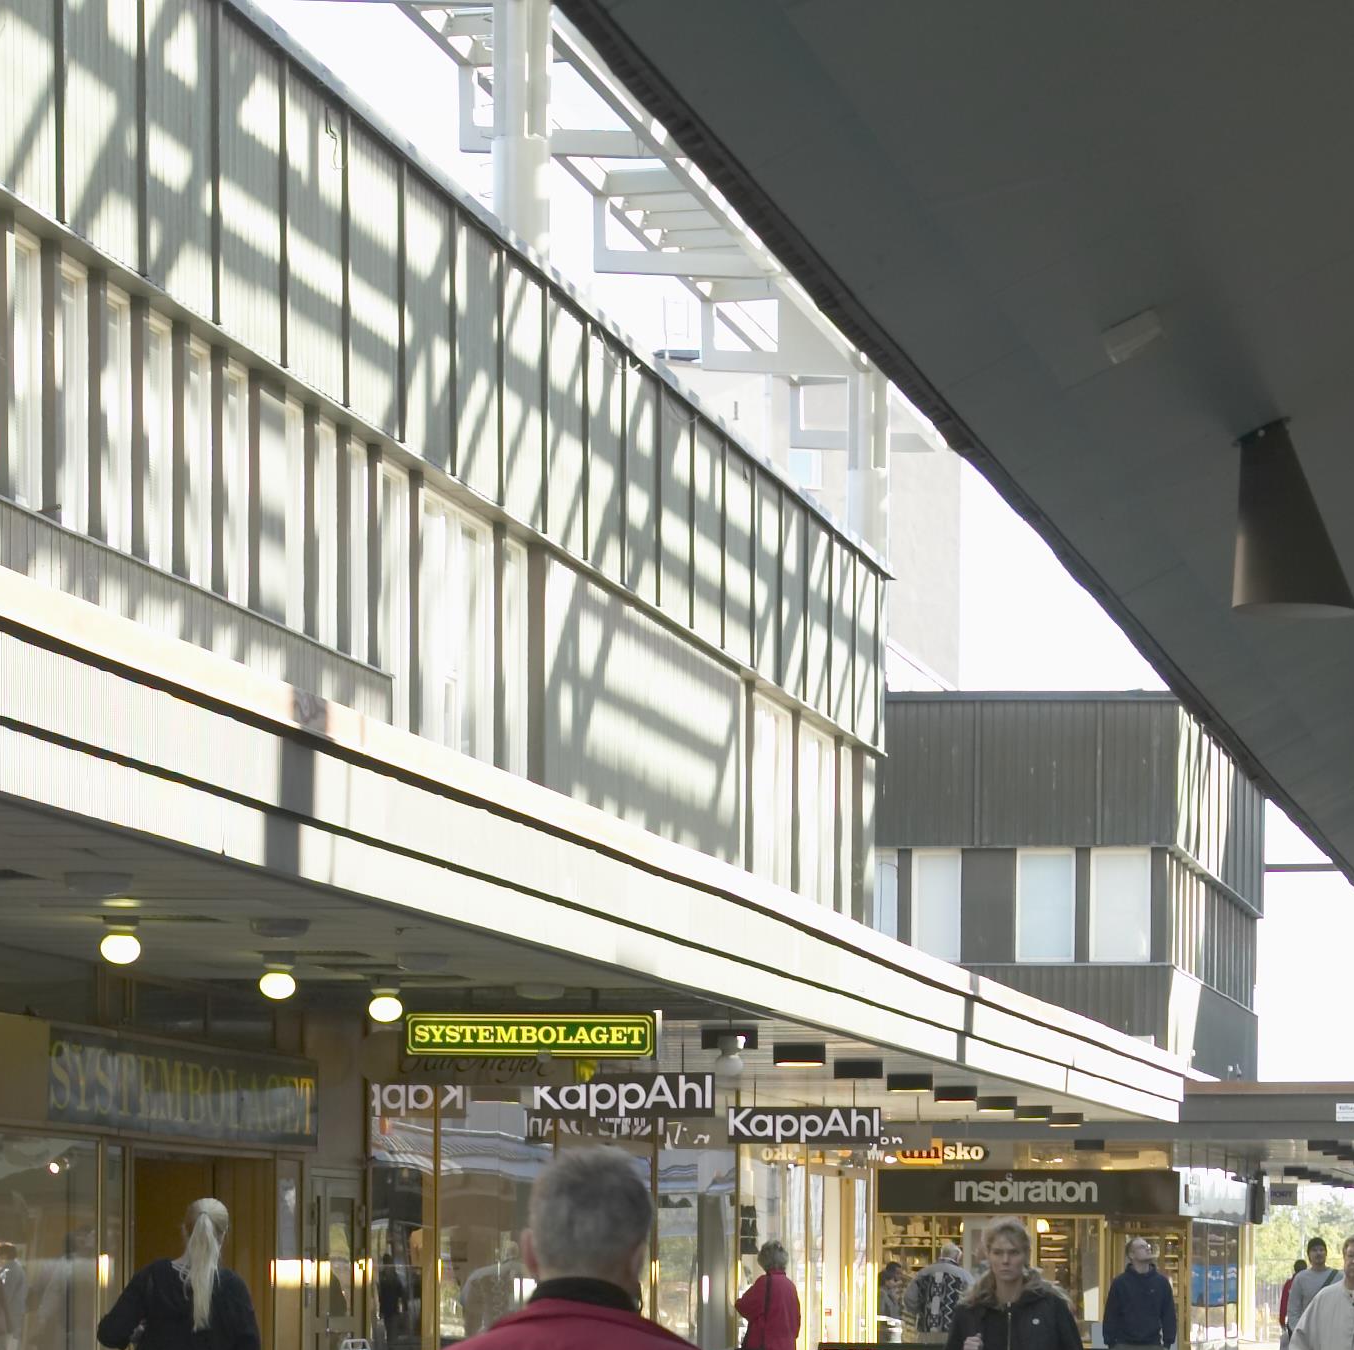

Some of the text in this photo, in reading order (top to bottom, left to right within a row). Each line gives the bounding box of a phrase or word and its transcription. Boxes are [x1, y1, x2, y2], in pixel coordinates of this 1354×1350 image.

[413, 1023, 646, 1046] SYSTEMBOLAGET
[50, 1039, 316, 1137] SYSTEMBOLAGET
[533, 1075, 712, 1117] KappAhl
[728, 1108, 880, 1143] KappAhl
[954, 1173, 1098, 1206] inspiration
